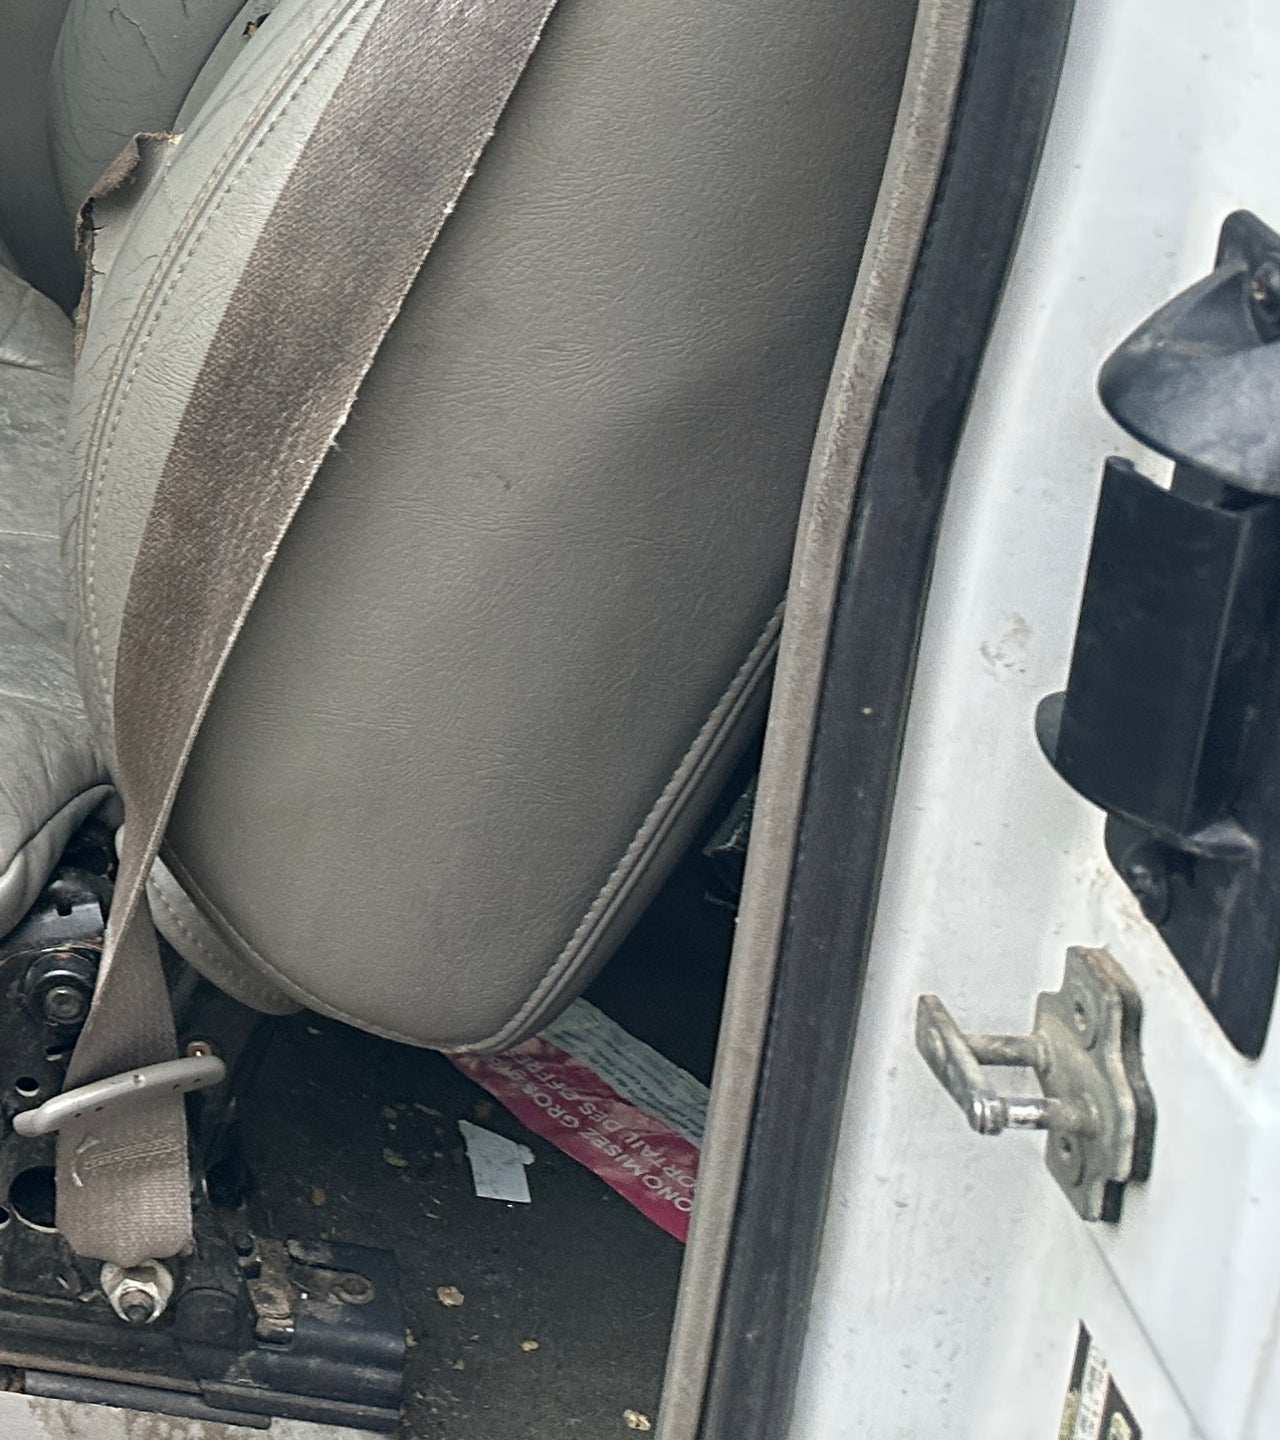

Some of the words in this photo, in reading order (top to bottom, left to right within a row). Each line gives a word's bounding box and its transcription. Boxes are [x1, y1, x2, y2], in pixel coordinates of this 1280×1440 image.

[521, 1083, 580, 1129] GROS
[578, 1102, 625, 1133] DES
[577, 1126, 694, 1212] ONOMISEZ
[623, 1130, 699, 1189] ORTAIL
